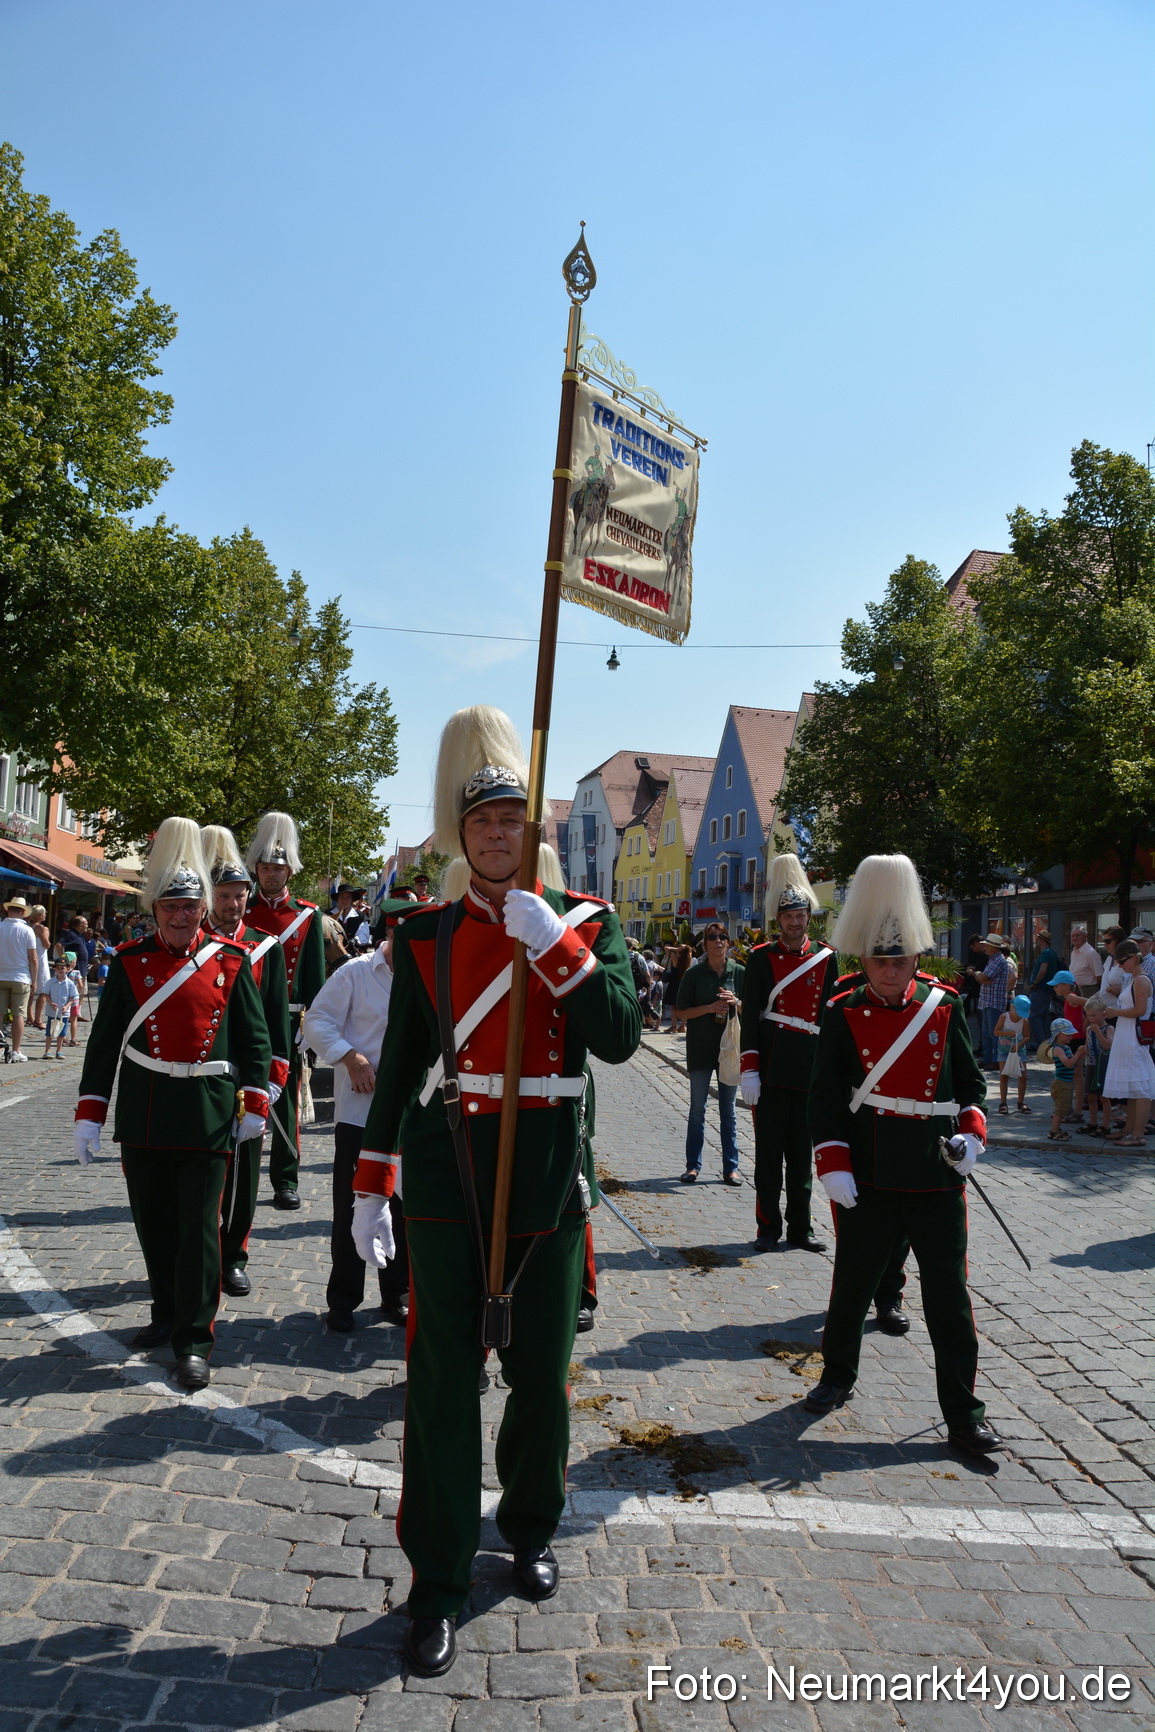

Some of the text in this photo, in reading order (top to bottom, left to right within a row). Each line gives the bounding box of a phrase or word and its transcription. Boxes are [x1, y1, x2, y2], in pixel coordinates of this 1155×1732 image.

[592, 401, 690, 471] TRADITIONS-
[610, 436, 669, 489] VEREIN
[606, 504, 663, 546] NEUMARKTER
[606, 524, 662, 562] CHEVAULEGERS
[583, 557, 672, 614] ESKADRON
